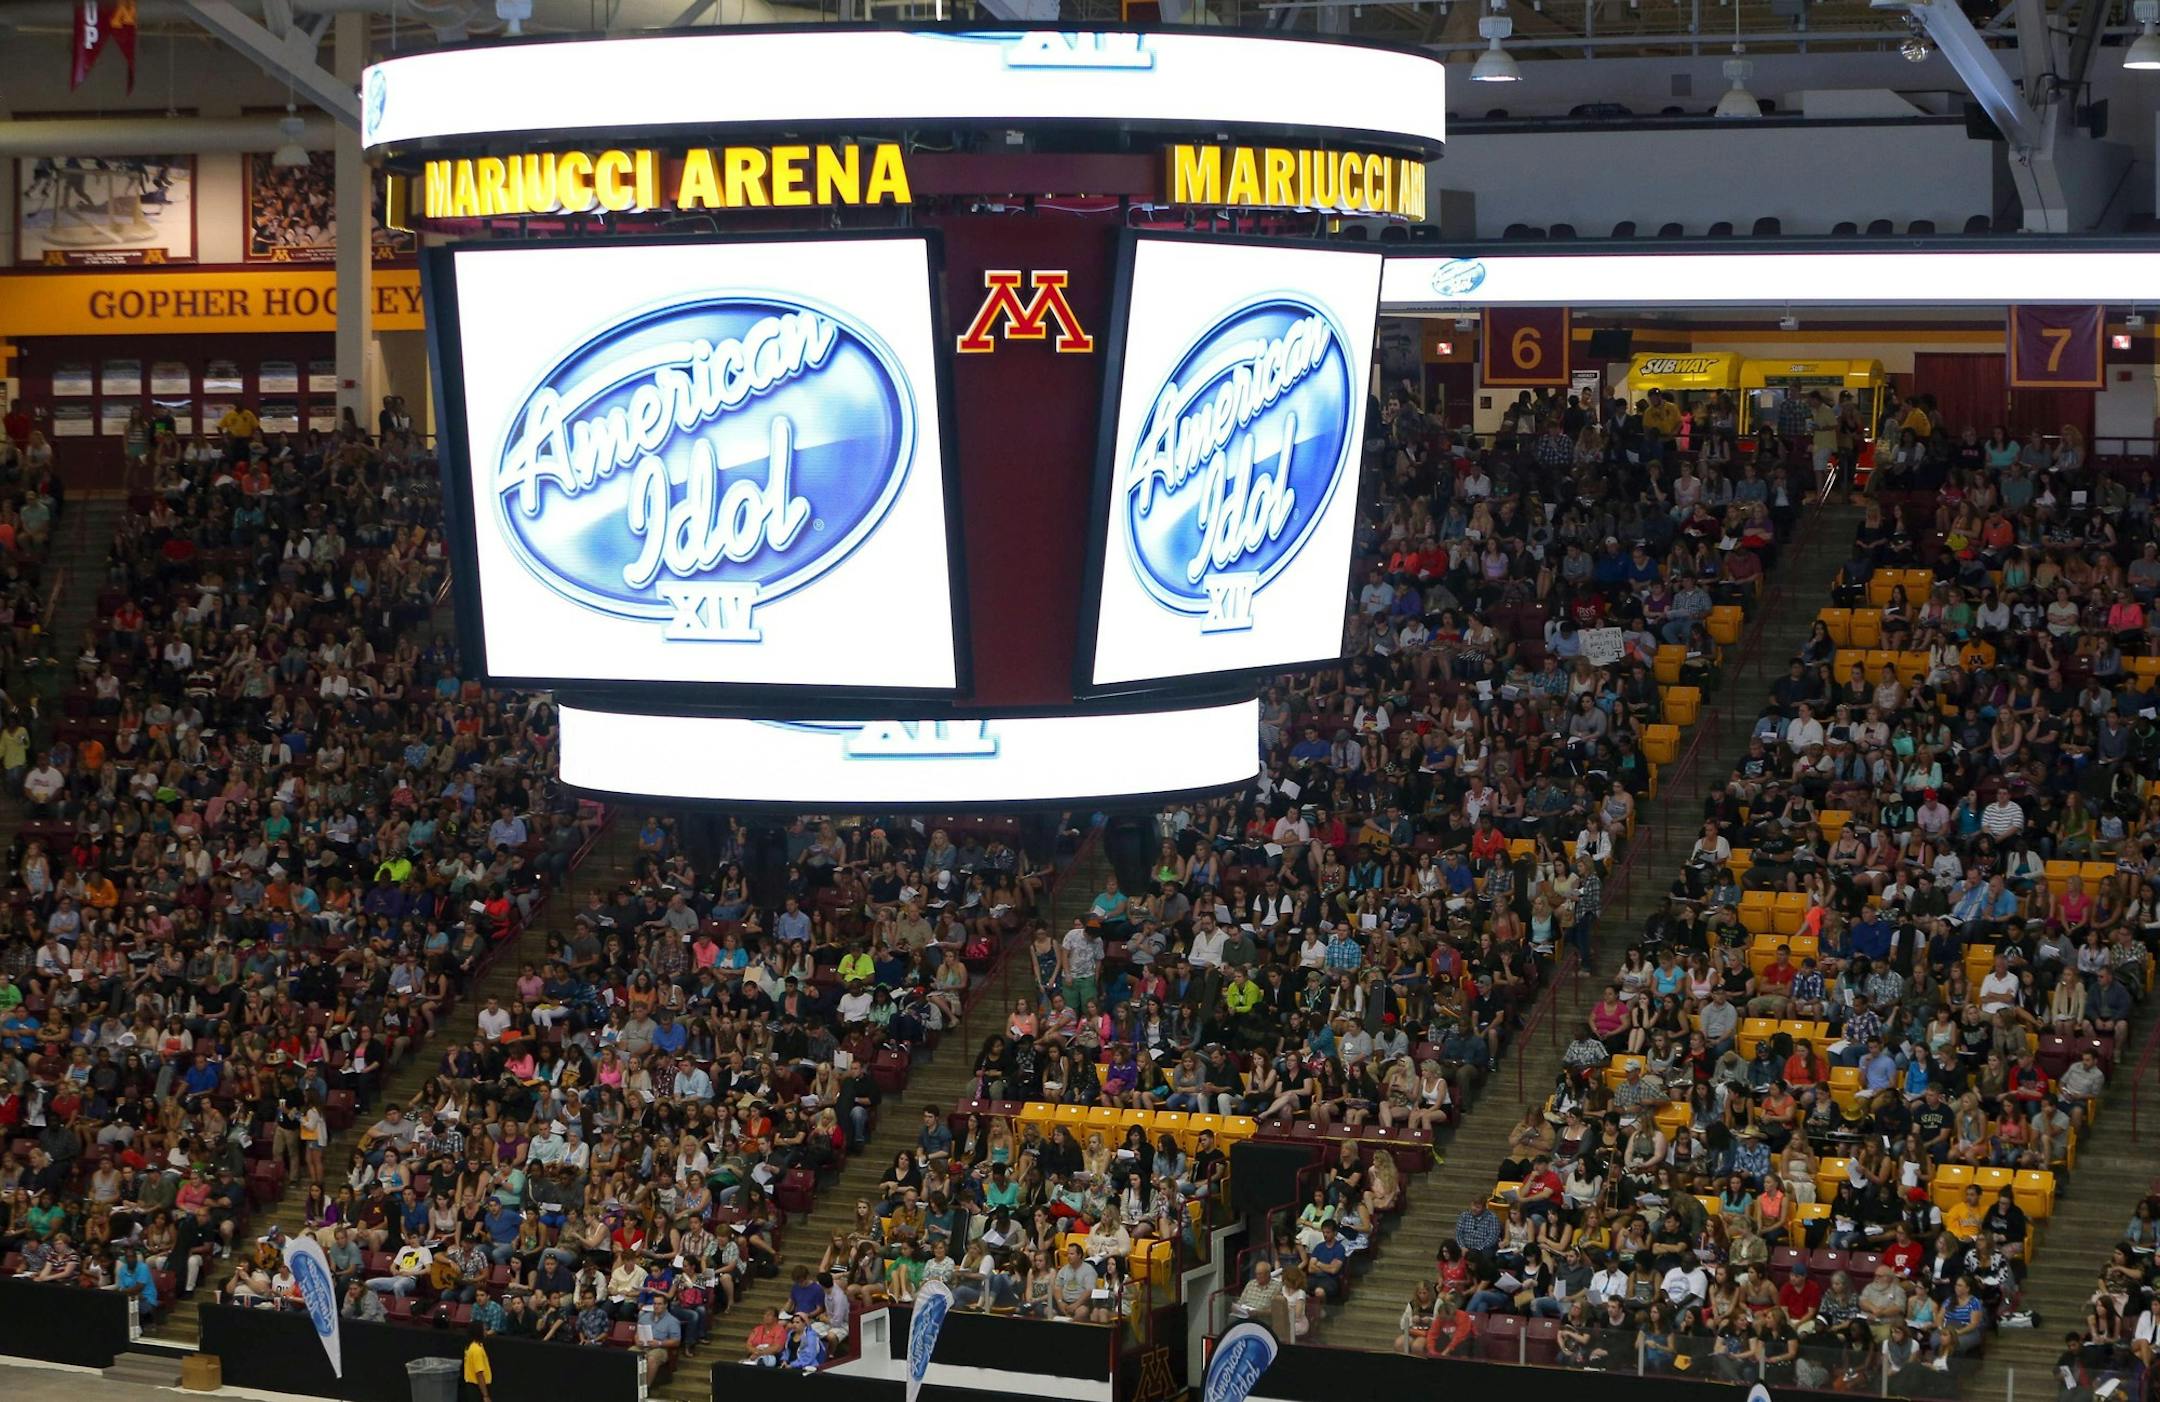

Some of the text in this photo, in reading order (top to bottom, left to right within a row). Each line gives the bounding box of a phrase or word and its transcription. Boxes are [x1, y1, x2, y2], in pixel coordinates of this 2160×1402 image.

[425, 144, 912, 218] MARIUCCI ARENA
[1174, 144, 1392, 212] MARIUCCI
[89, 286, 422, 320] GOPHER HOCEY
[956, 269, 1095, 354] M
[1511, 326, 1543, 370] 6
[1640, 358, 1719, 376] SUBWAY
[2041, 328, 2072, 372] 7
[497, 308, 840, 519] American
[1126, 312, 1332, 515] American
[622, 411, 812, 590] Idol
[1186, 411, 1297, 585] Idol
[655, 580, 764, 645] XIV
[1199, 570, 1261, 637] XIV
[1207, 1338, 1246, 1401] American
[1230, 1360, 1261, 1398] Idol
